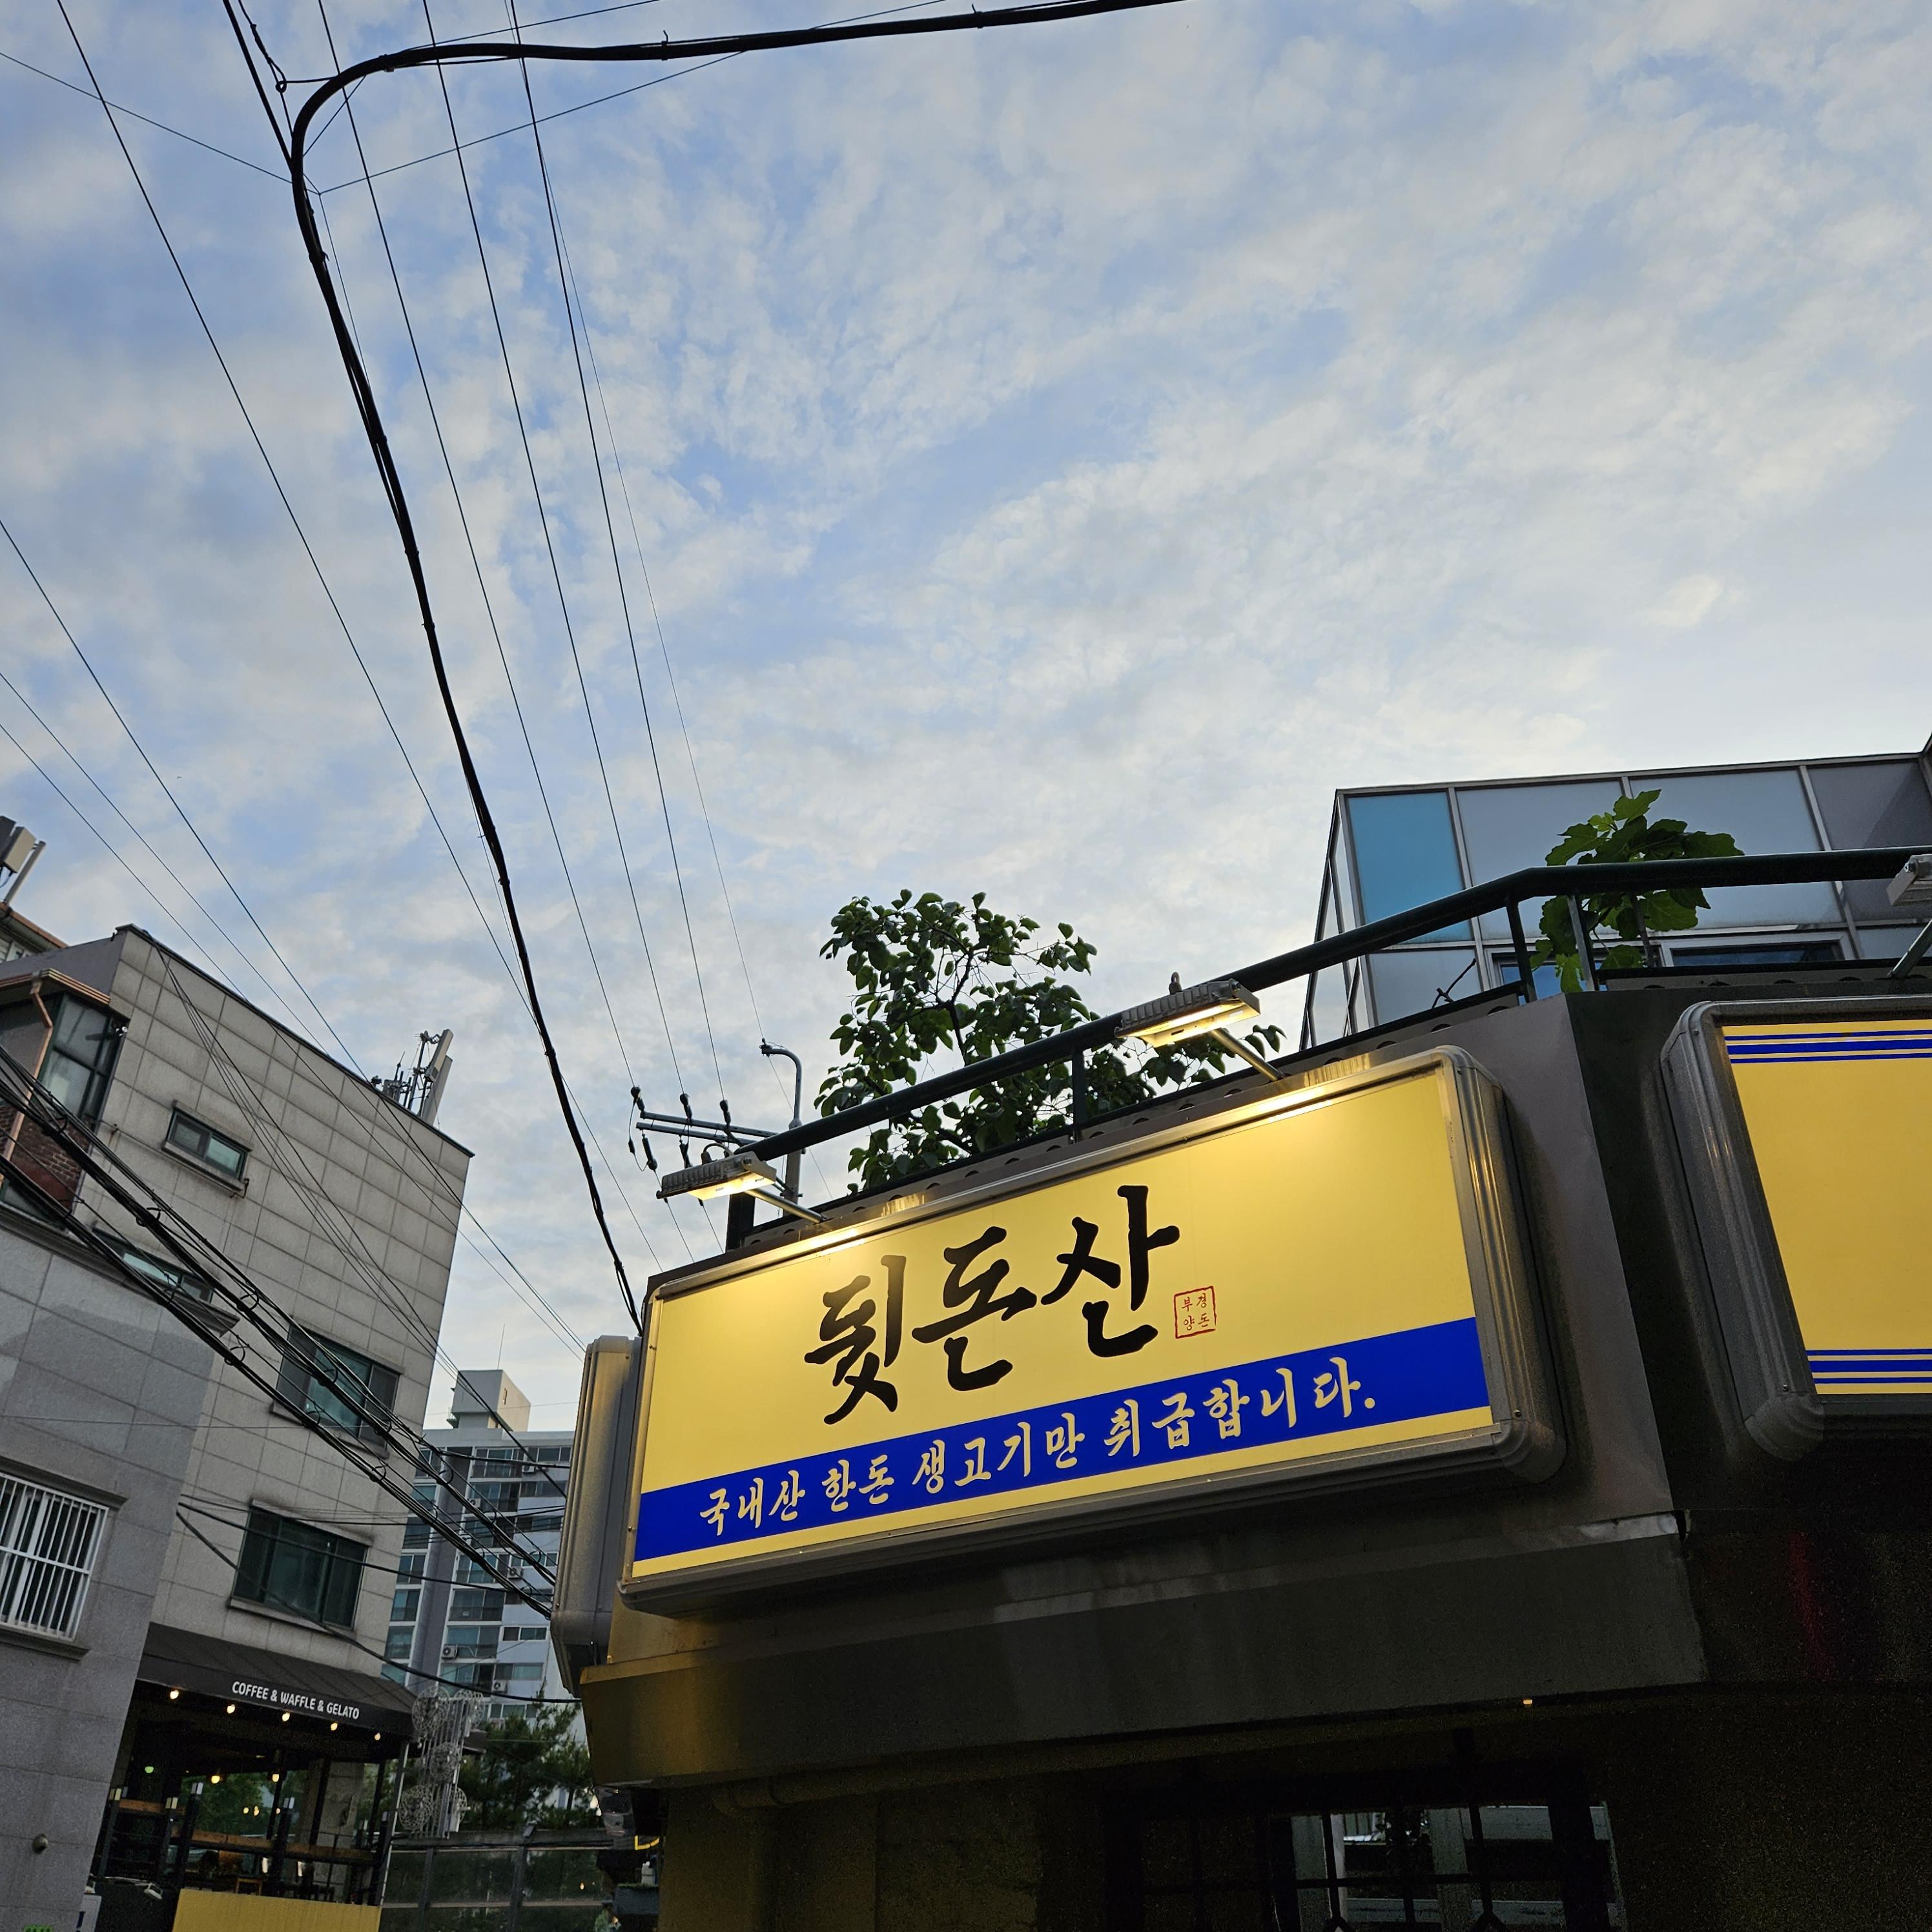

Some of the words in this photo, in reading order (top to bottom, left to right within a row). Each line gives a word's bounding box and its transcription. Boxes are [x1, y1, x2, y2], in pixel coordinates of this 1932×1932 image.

[805, 1186, 1180, 1425] 뒷돈산
[1181, 1292, 1207, 1312] 부경
[1183, 1312, 1210, 1331] 양돈
[700, 1470, 806, 1536] 국내산
[821, 1455, 894, 1512] 한돈
[912, 1413, 1085, 1494] 생고기만
[1104, 1357, 1375, 1457] 취급합니다.
[232, 1681, 269, 1700] COFFEE
[270, 1689, 278, 1702] &
[280, 1691, 316, 1711] WAFFLE
[317, 1700, 324, 1712] &
[326, 1702, 360, 1720] GELATO
